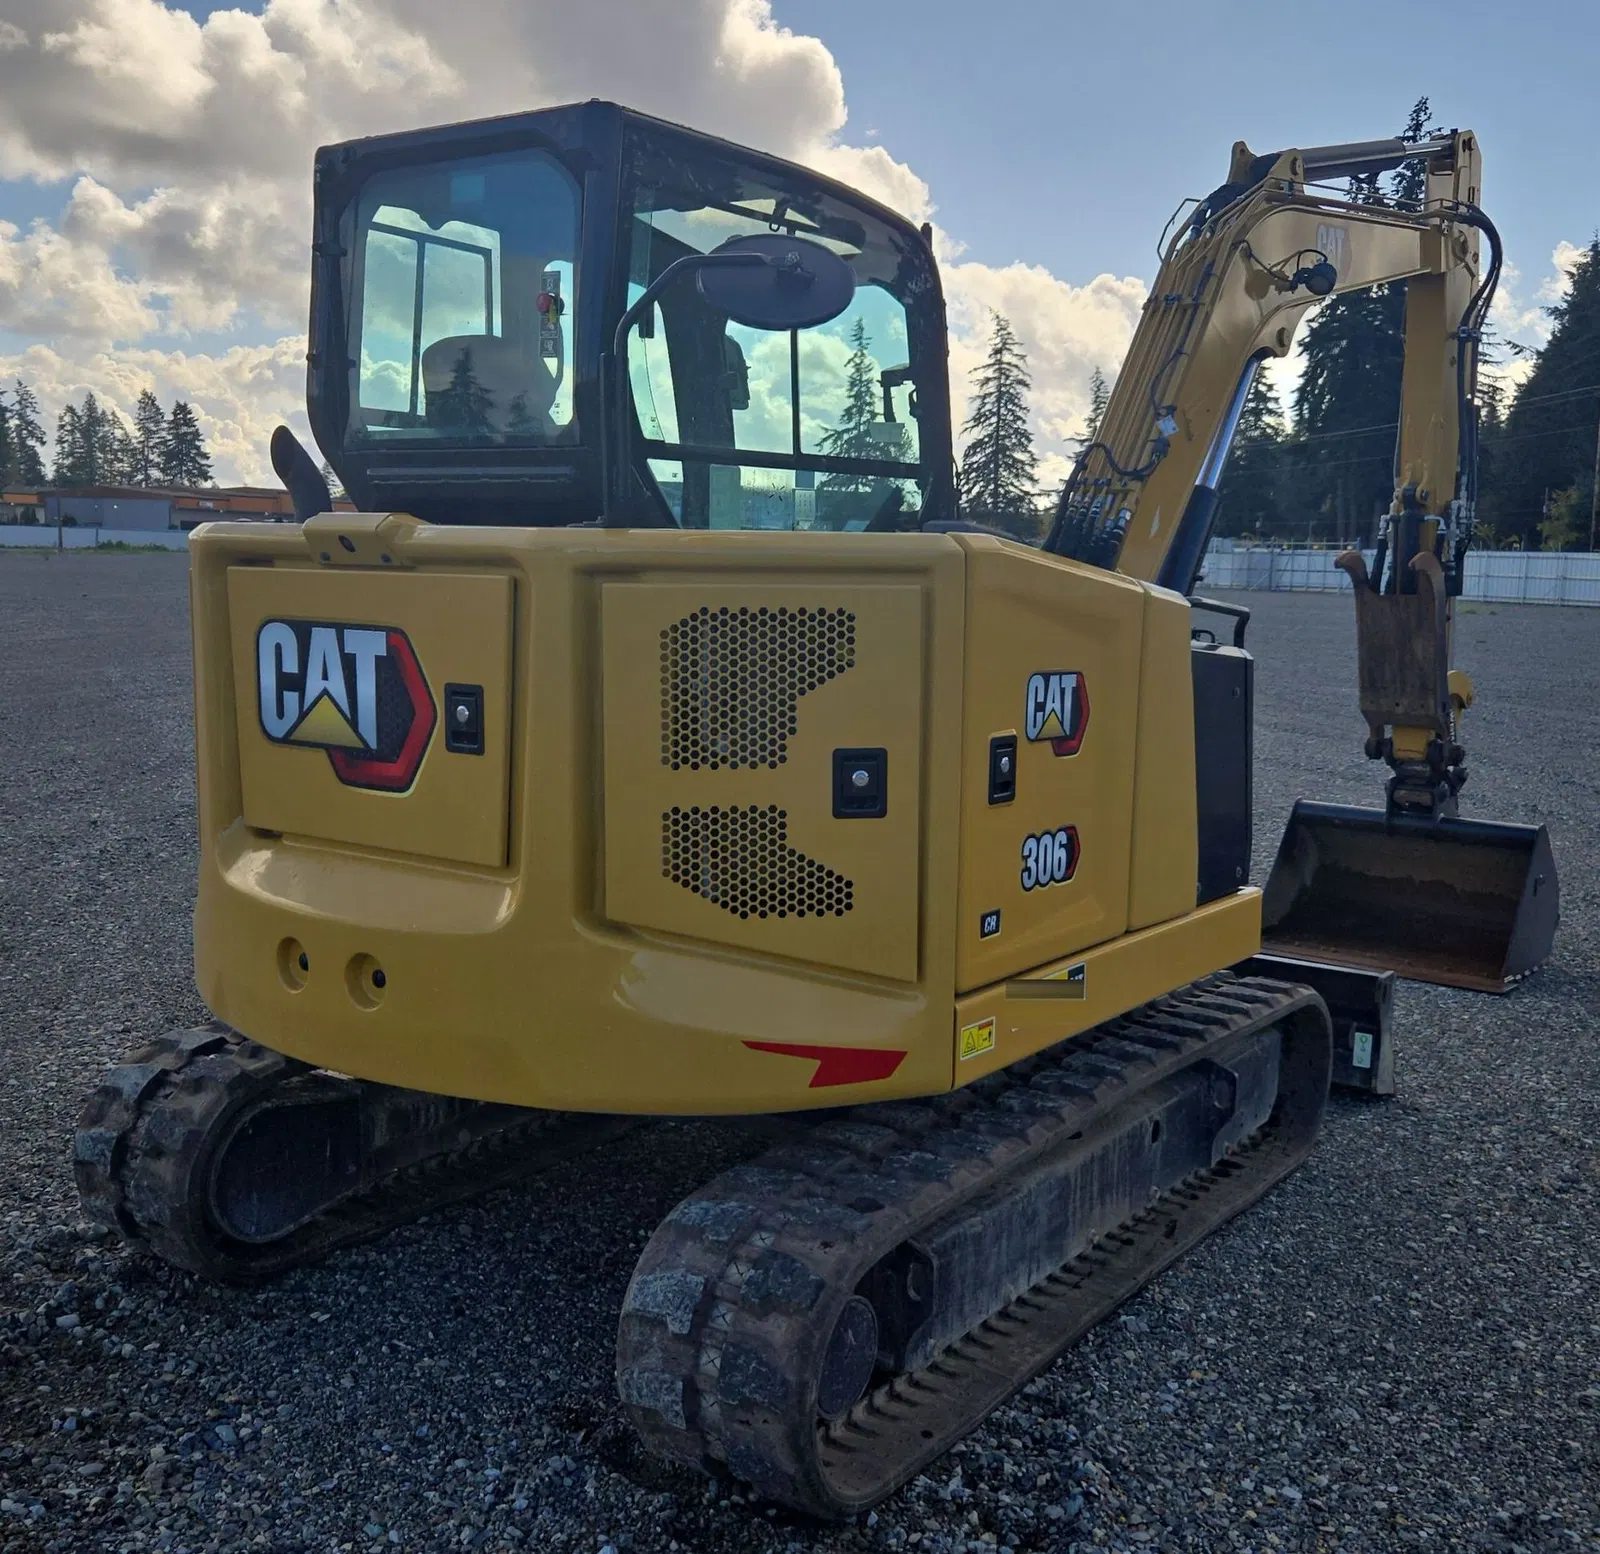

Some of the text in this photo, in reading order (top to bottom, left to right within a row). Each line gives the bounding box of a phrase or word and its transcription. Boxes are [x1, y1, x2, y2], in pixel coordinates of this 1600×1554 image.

[1316, 225, 1345, 269] CAT
[258, 621, 387, 750] CAT
[1026, 673, 1078, 741] CAT
[1022, 830, 1067, 889] 306
[984, 914, 998, 934] CR
